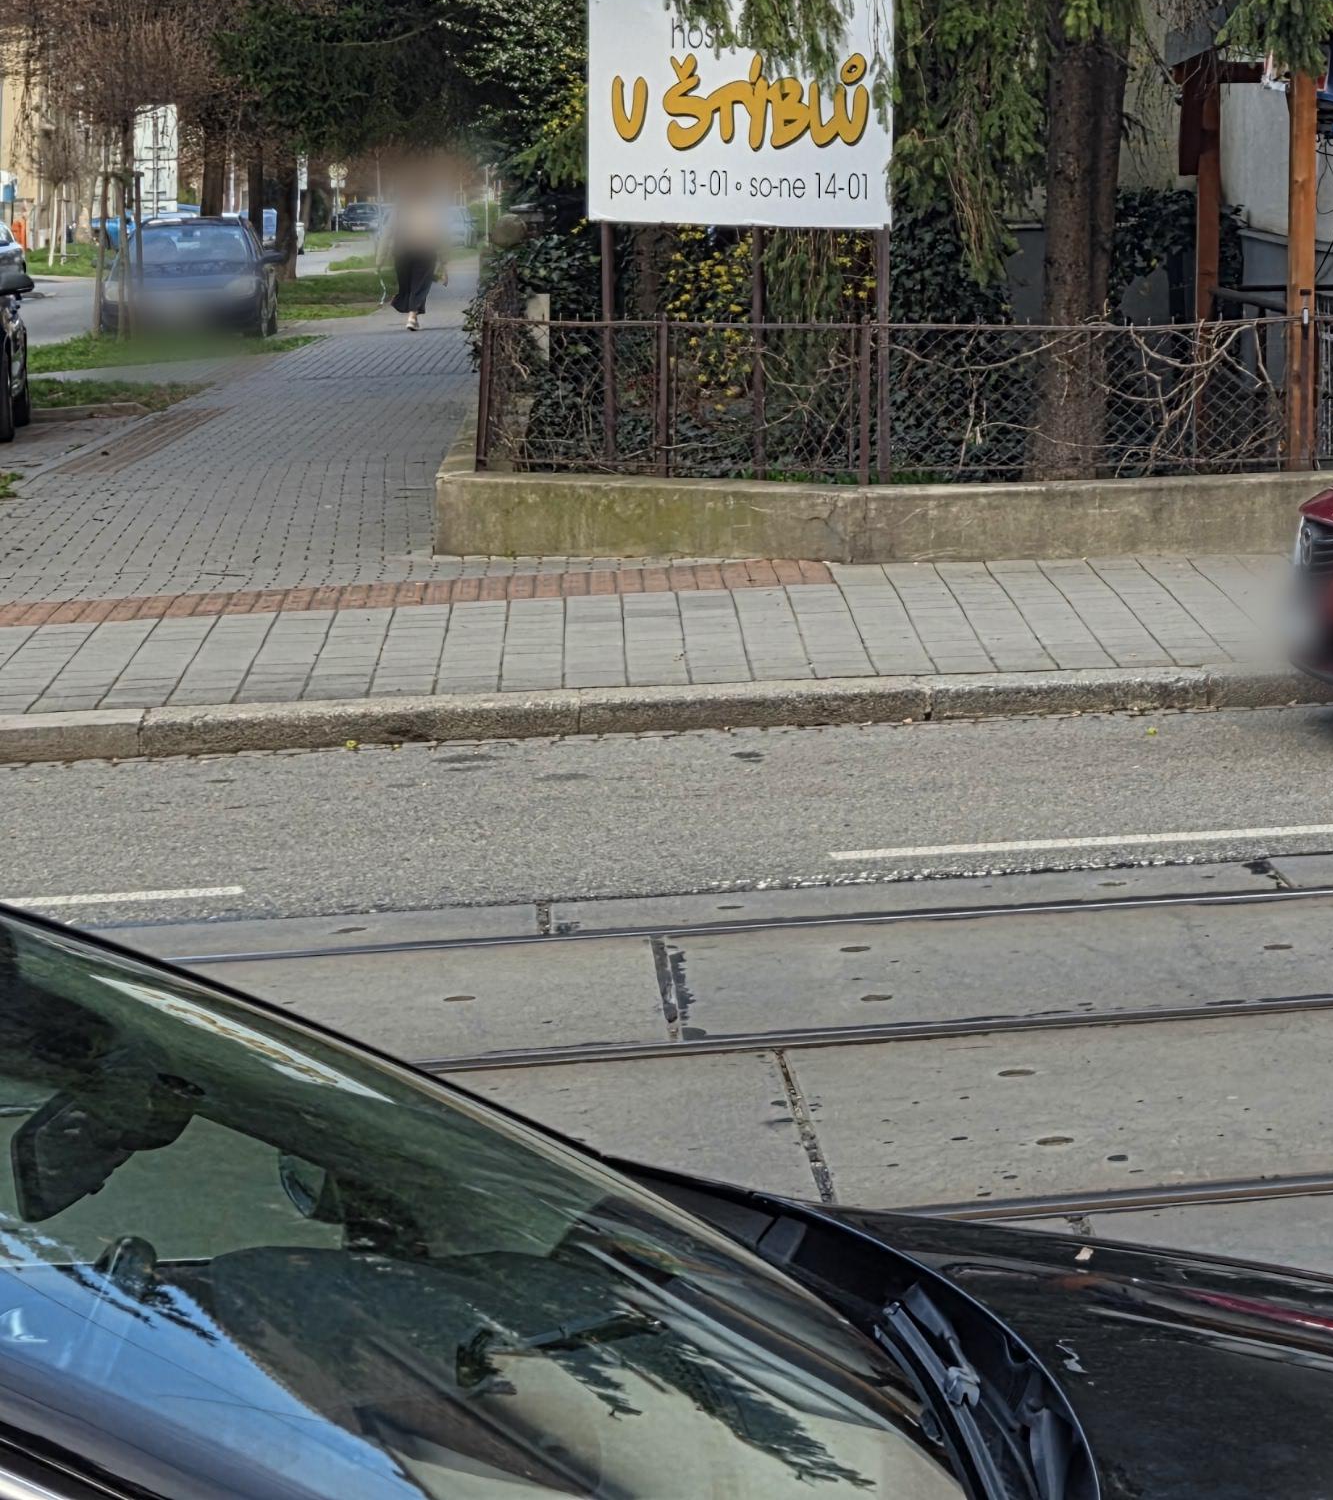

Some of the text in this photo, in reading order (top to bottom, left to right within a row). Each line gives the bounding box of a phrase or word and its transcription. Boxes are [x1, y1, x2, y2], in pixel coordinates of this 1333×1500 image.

[611, 75, 648, 142] U
[610, 168, 868, 200] po-pá 13-01 so-ne 14-01
